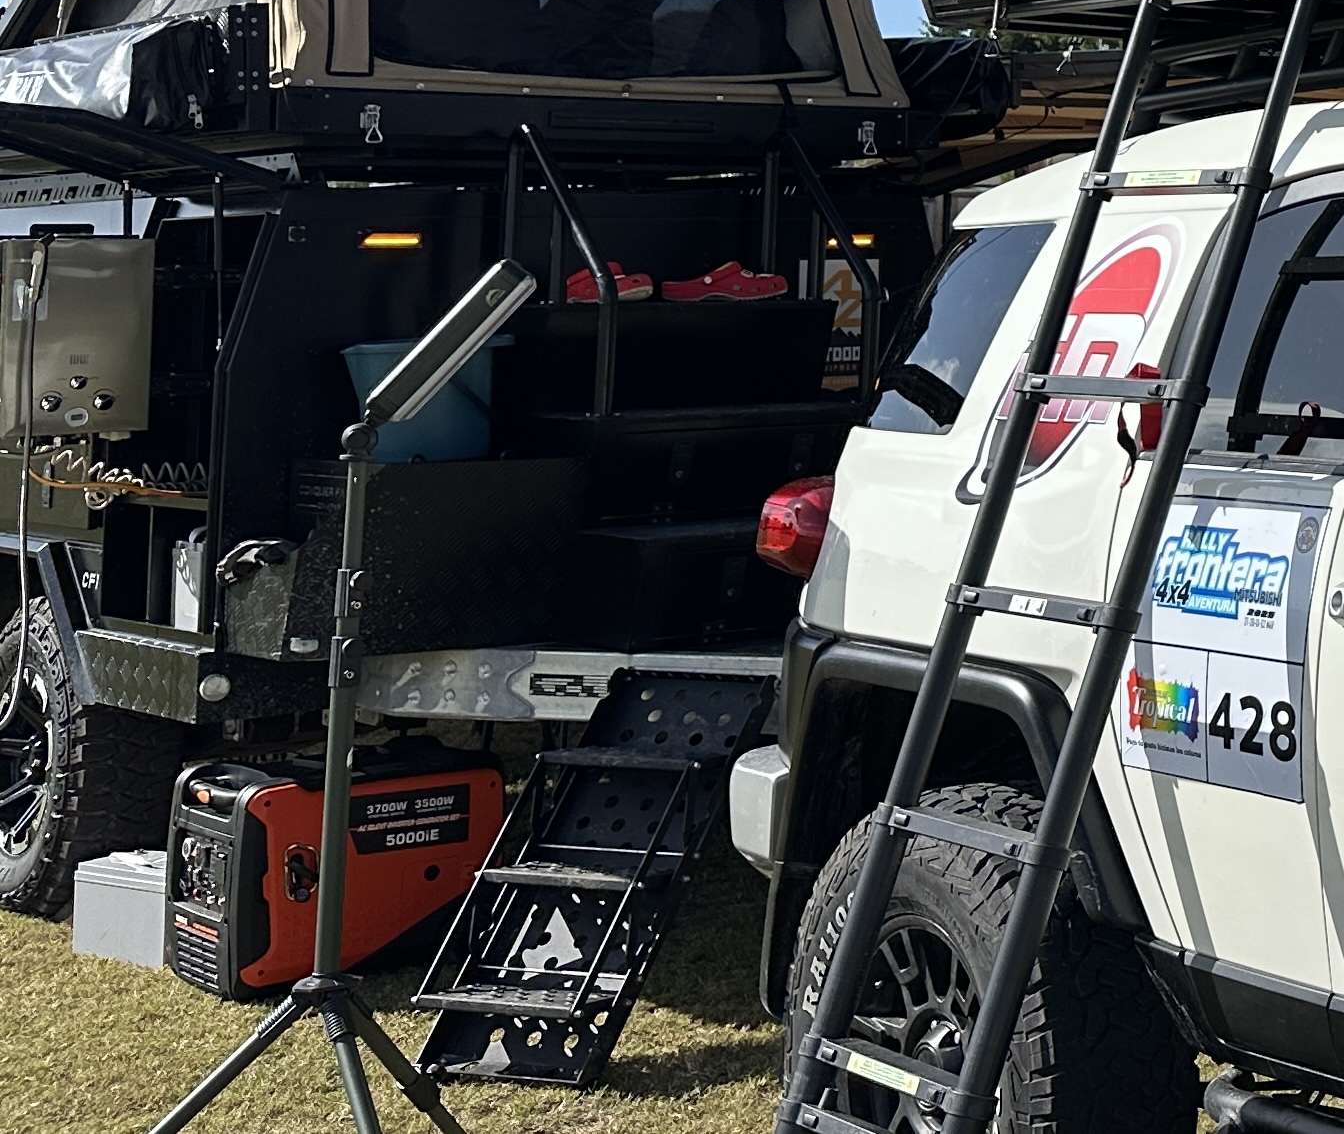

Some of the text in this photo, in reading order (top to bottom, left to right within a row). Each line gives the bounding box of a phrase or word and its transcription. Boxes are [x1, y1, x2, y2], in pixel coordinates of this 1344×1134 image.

[1155, 539, 1288, 593] frontera
[1155, 577, 1192, 606] 4x4
[1233, 587, 1283, 607] MITSUBISHI
[1188, 594, 1237, 615] AVENTURA
[1132, 685, 1197, 729] Tropical
[1208, 692, 1297, 763] 428
[366, 800, 409, 815] 3700W
[385, 828, 440, 847] 5000iE
